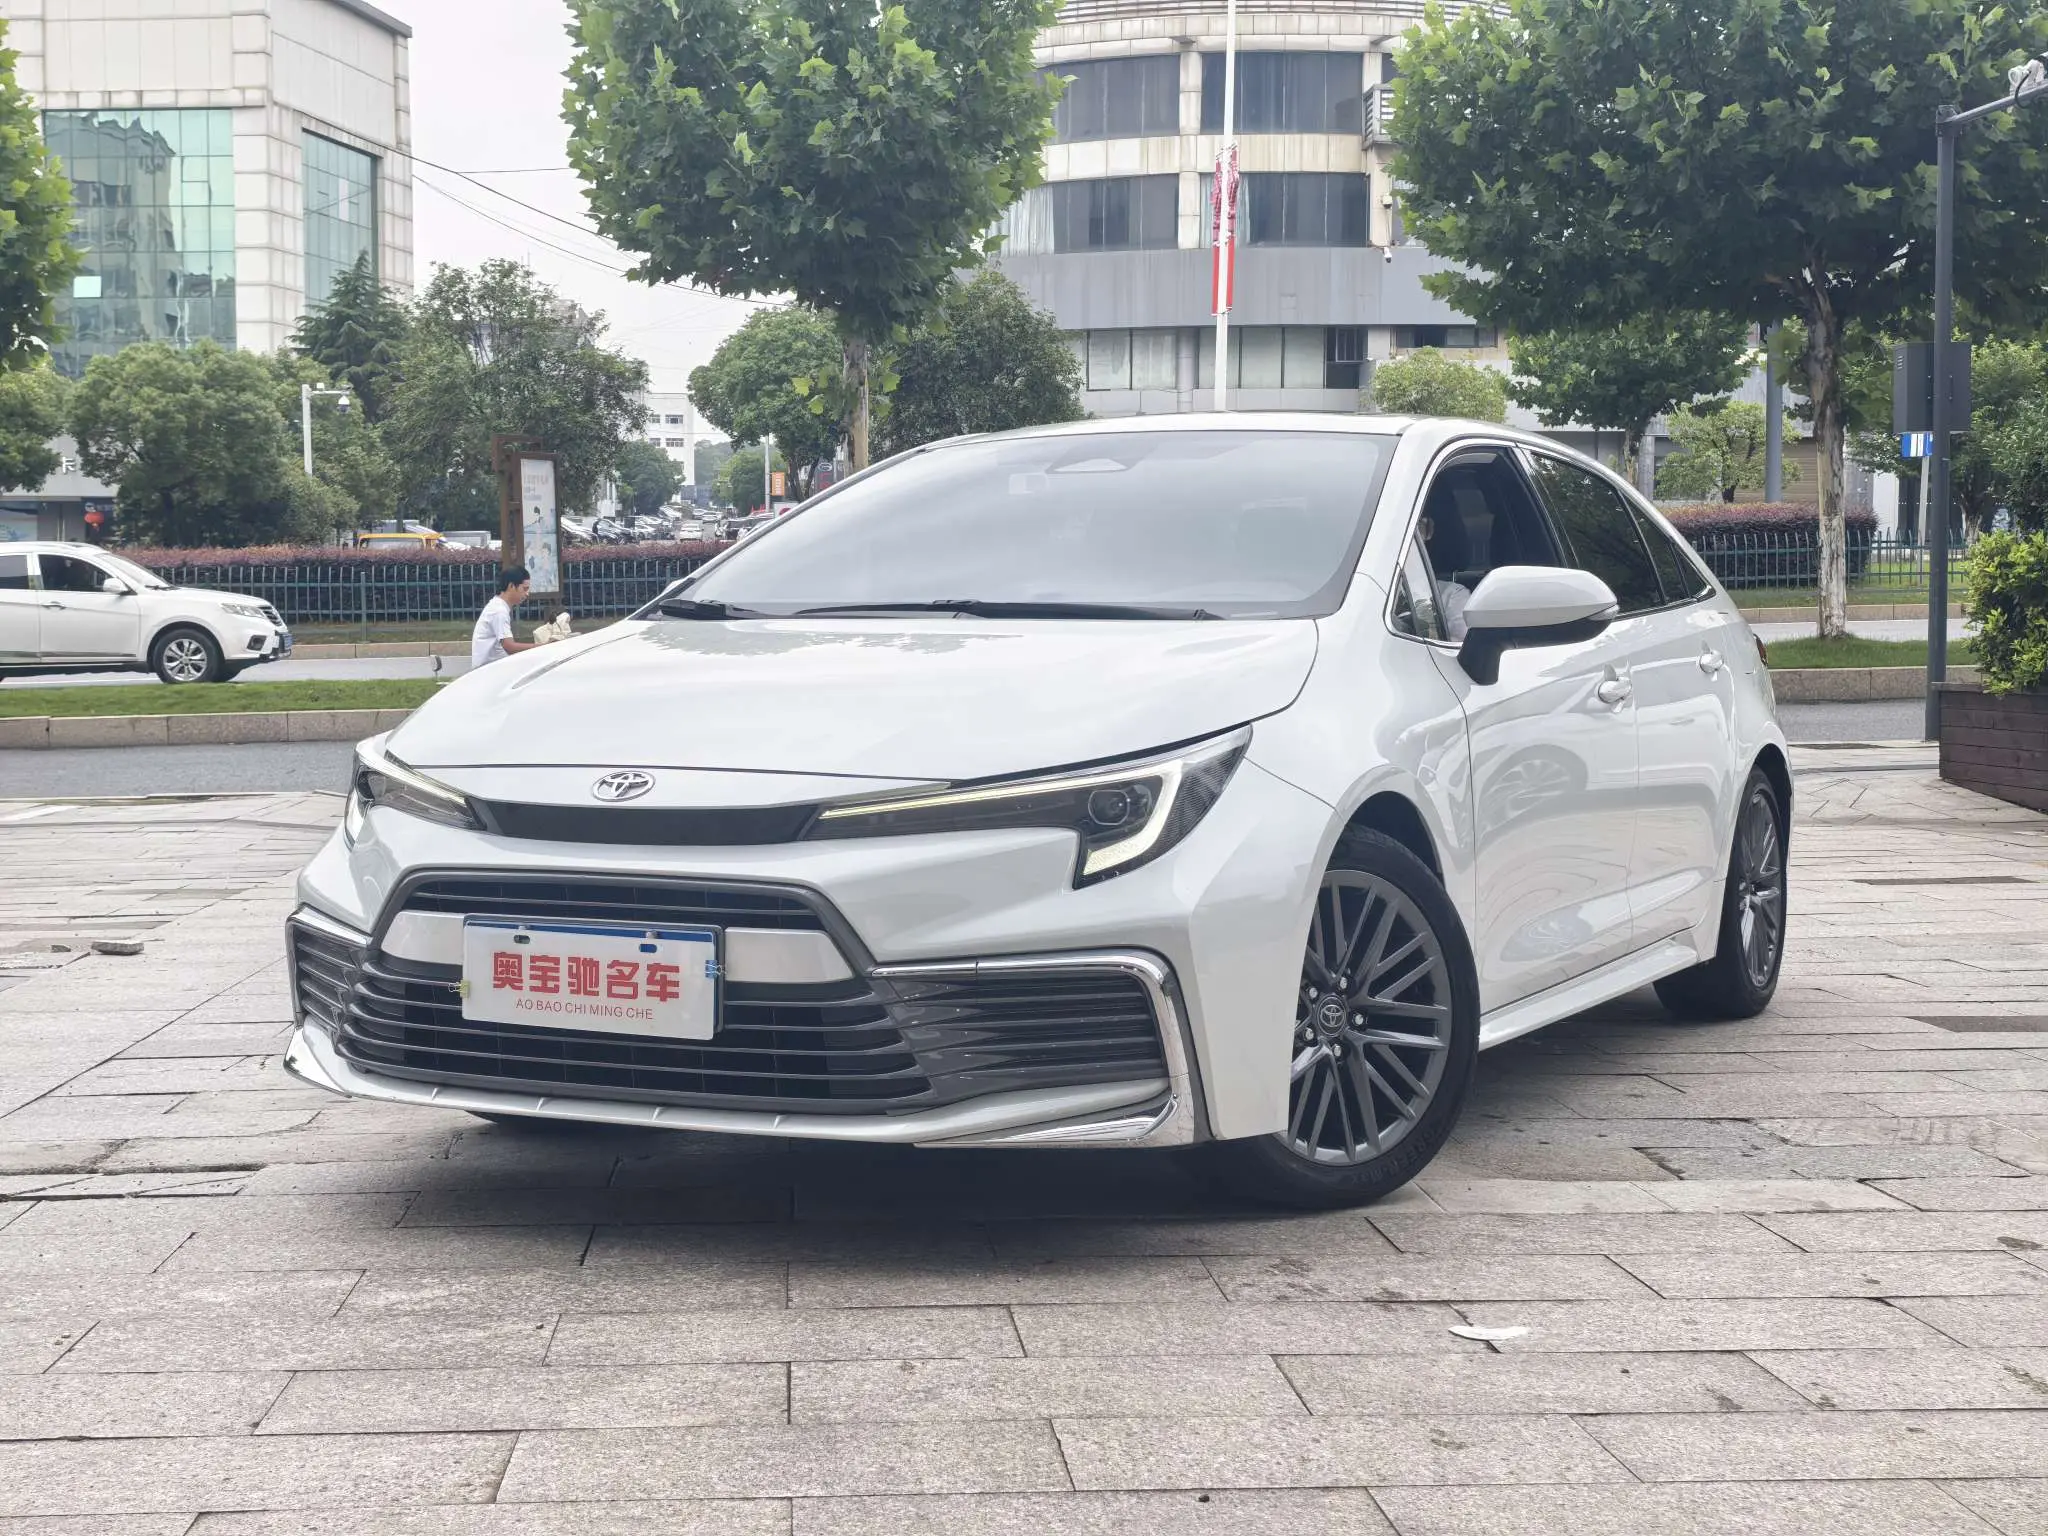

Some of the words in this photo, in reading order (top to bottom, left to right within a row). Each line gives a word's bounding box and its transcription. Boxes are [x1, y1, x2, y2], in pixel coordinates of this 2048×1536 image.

[493, 952, 680, 1002] 奥宝驰名车
[516, 998, 533, 1010] AO
[536, 1000, 562, 1012] BAO
[565, 1002, 586, 1014] CHI
[589, 1004, 623, 1018] MING
[626, 1007, 653, 1020] CHE
